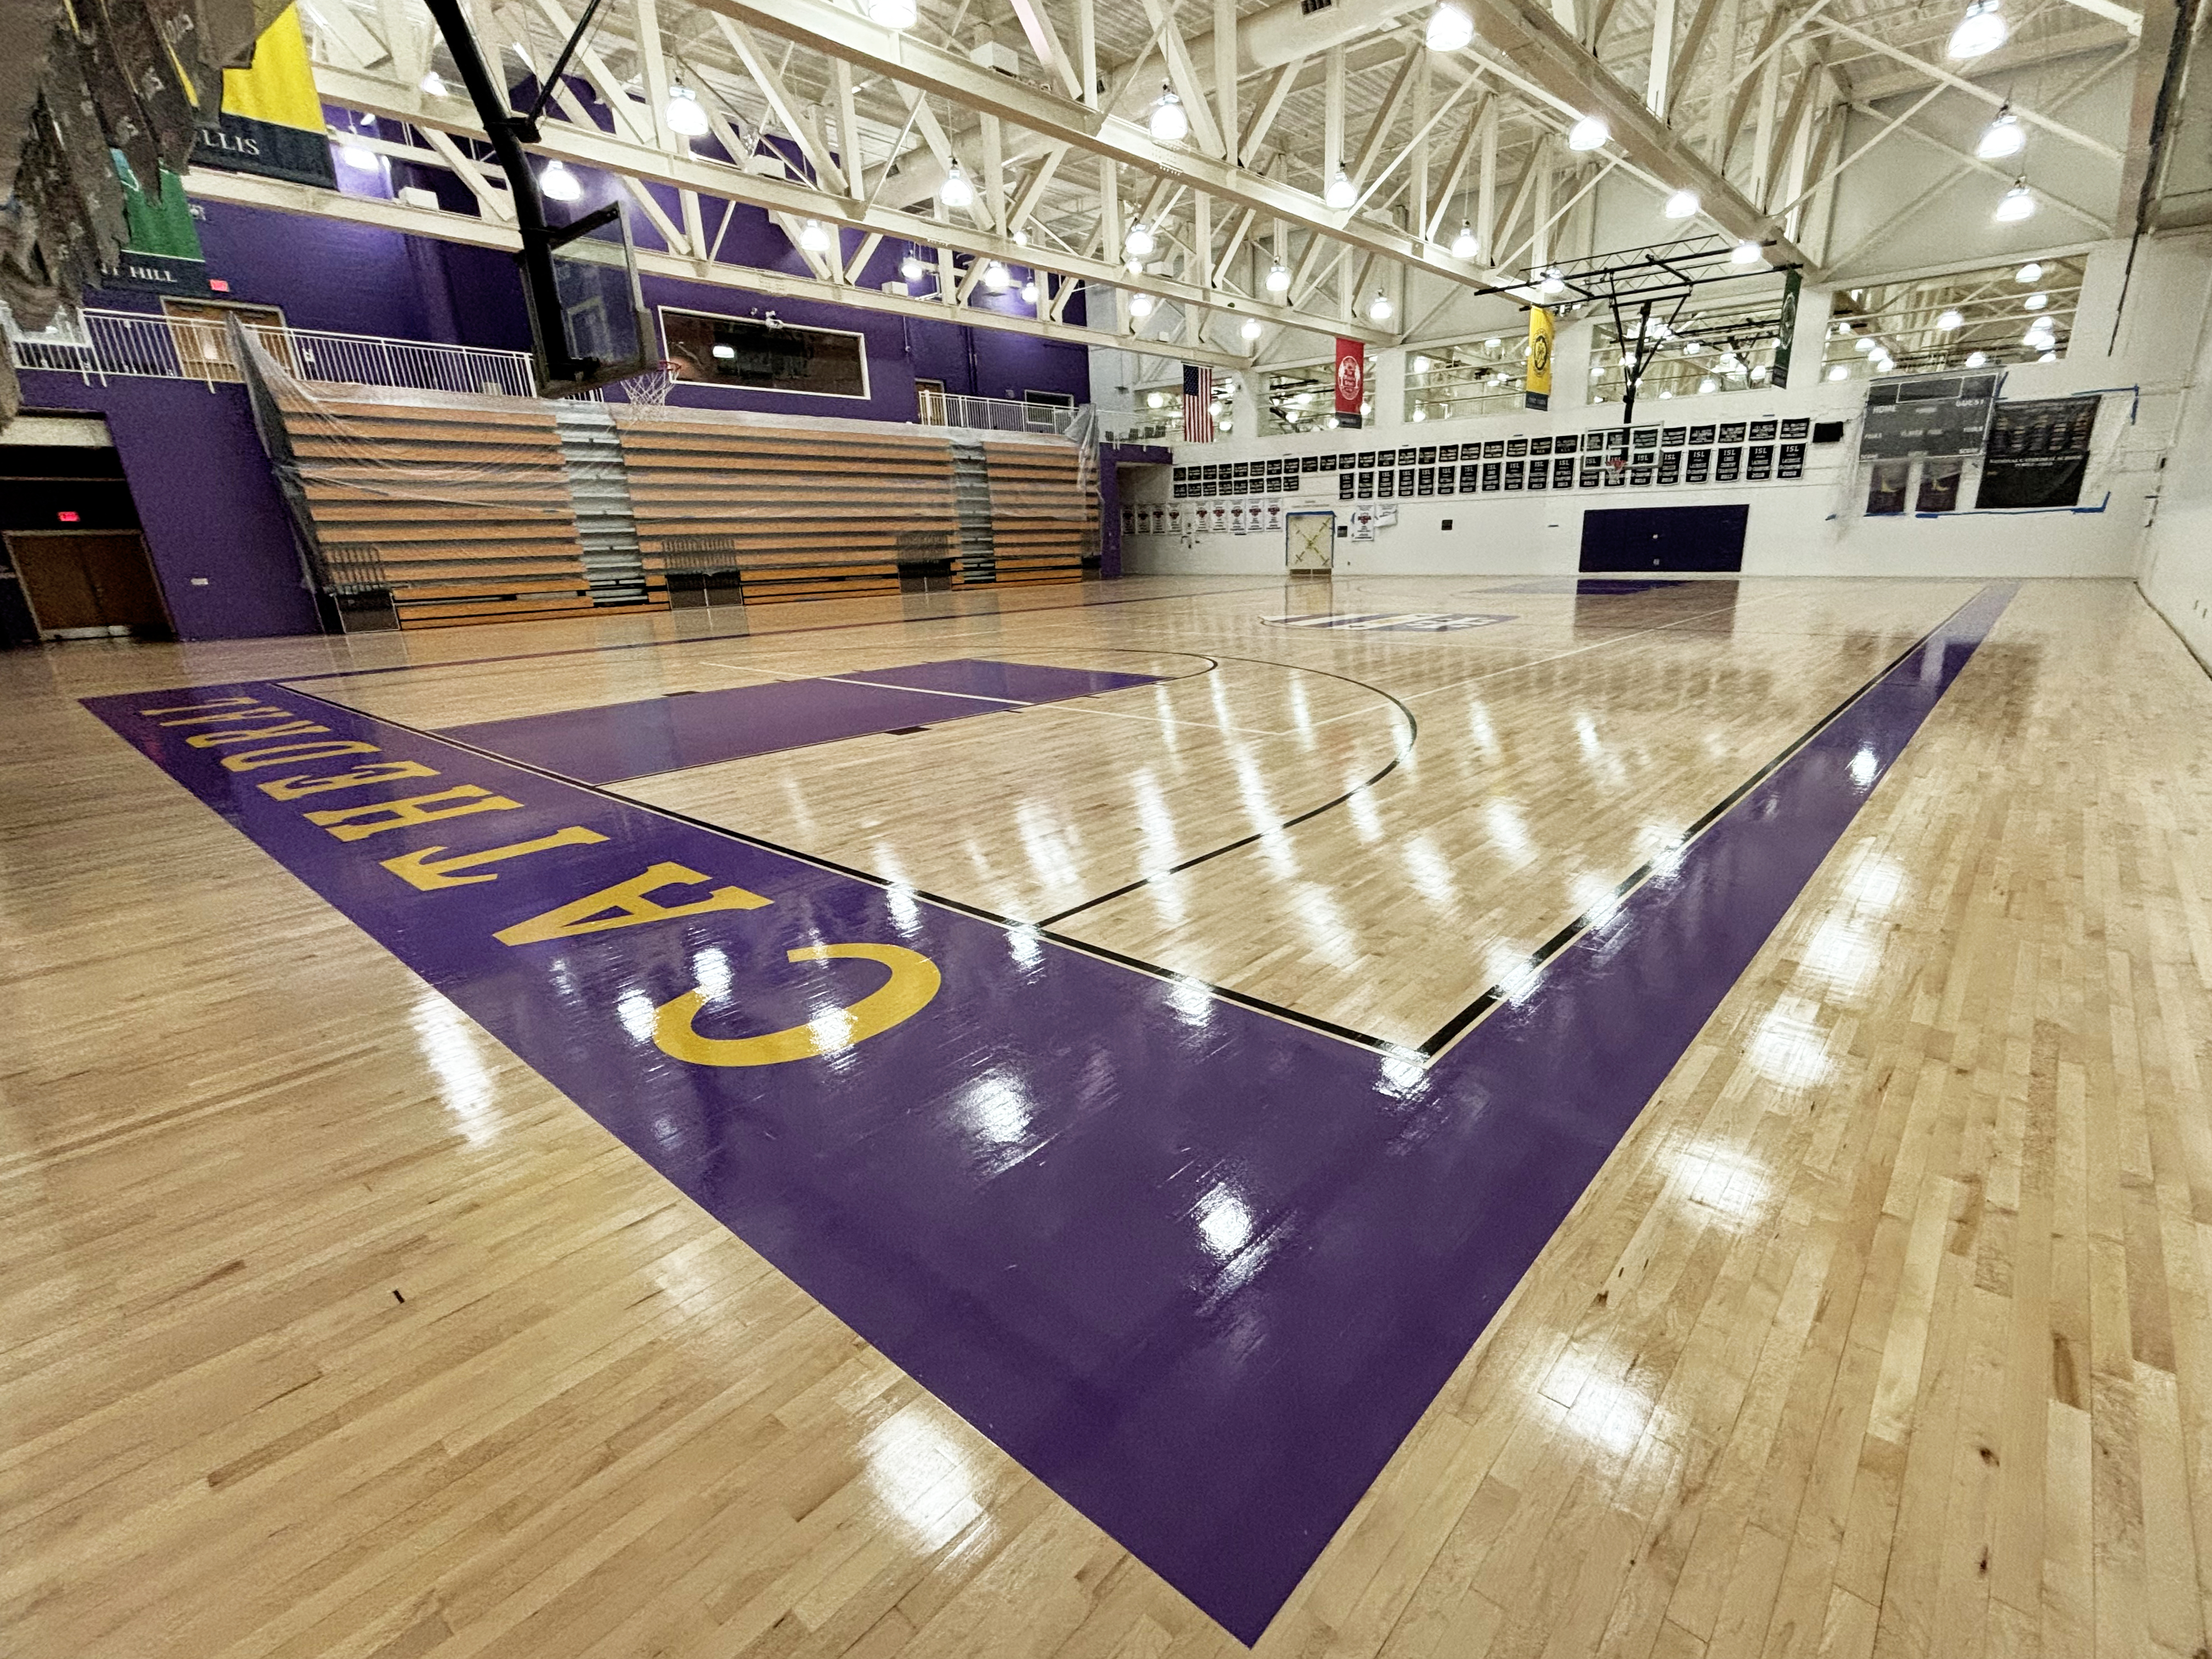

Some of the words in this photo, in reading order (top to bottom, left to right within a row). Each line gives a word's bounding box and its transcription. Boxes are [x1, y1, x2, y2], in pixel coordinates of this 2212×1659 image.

[202, 129, 260, 155] LLIS
[129, 266, 178, 283] HILL
[1872, 404, 1897, 414] HOME
[1955, 399, 1985, 408] GUEST
[139, 697, 942, 1067] CATHEDRAL
